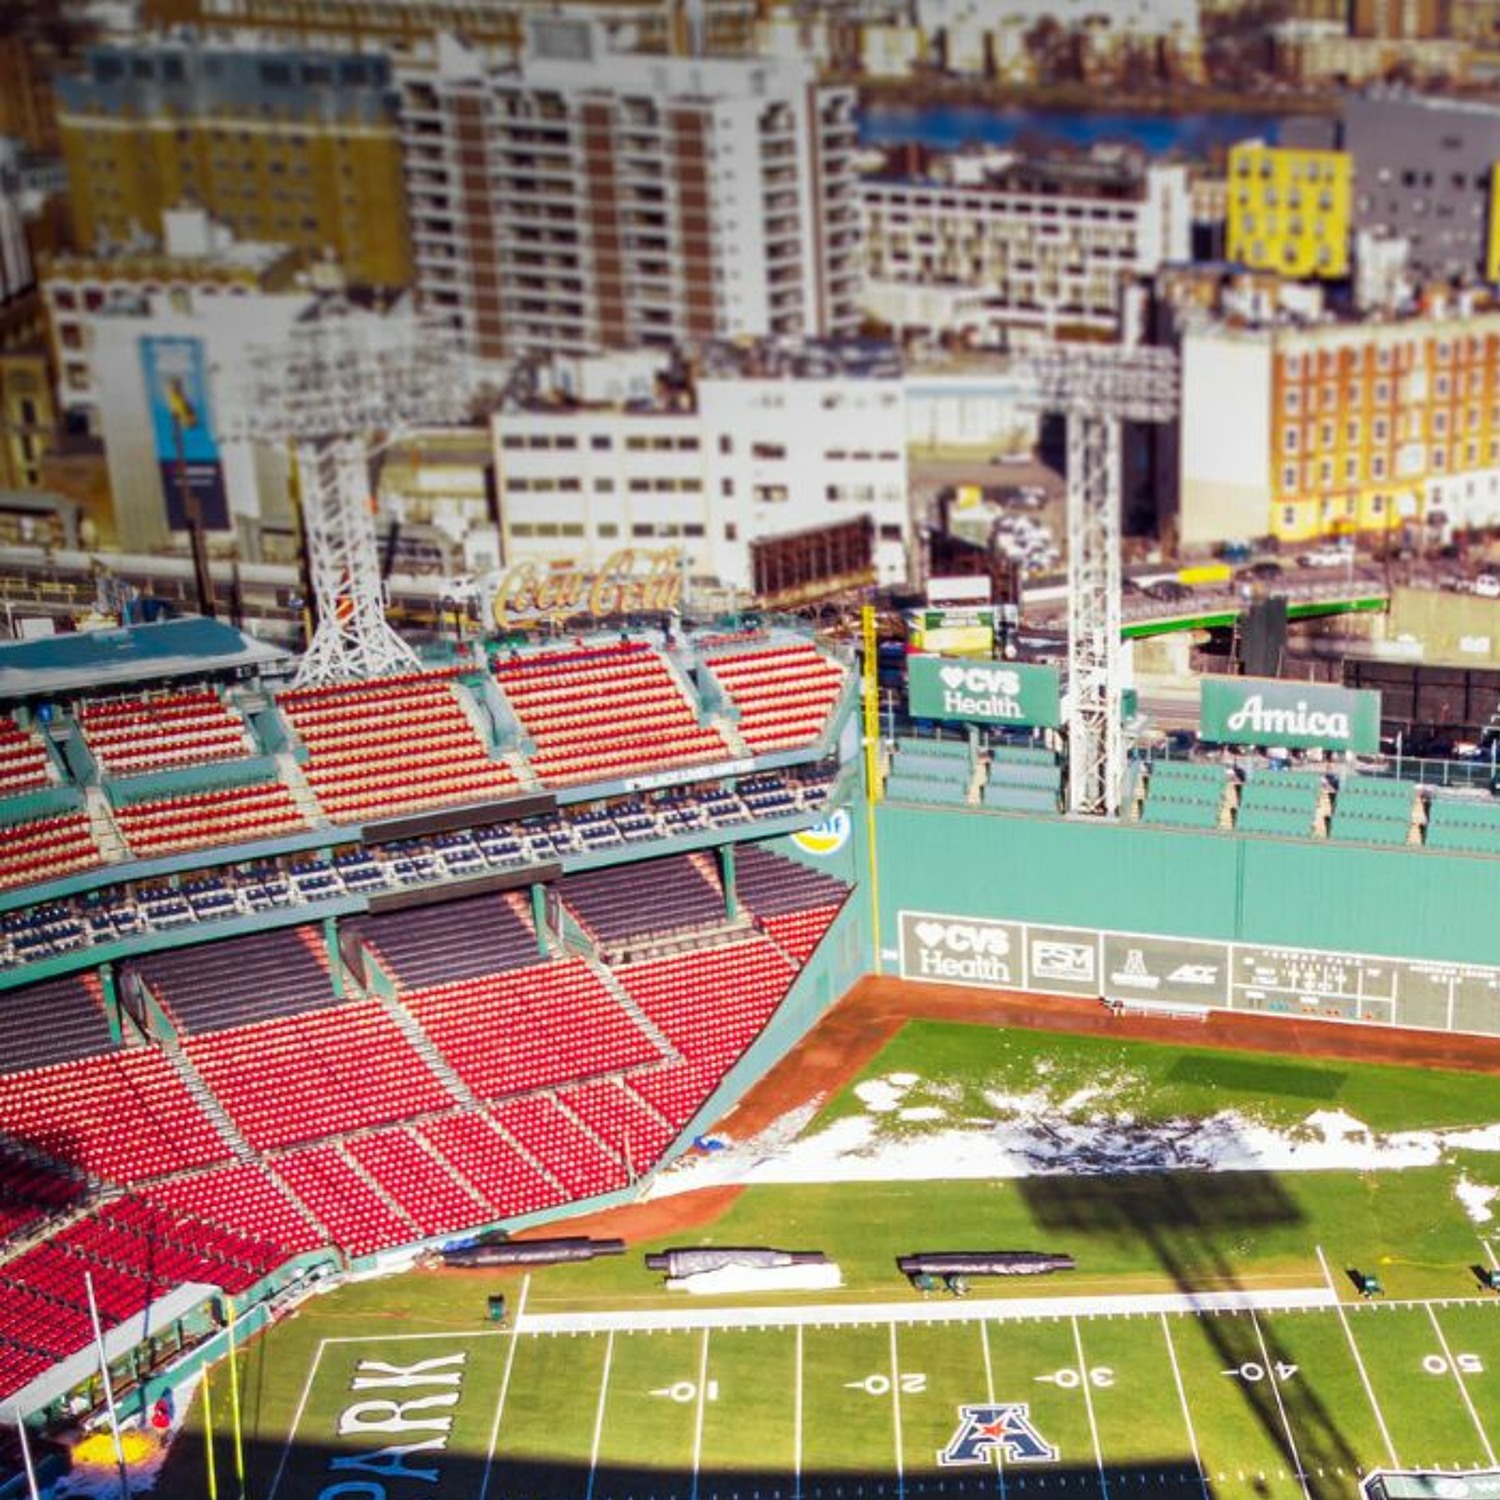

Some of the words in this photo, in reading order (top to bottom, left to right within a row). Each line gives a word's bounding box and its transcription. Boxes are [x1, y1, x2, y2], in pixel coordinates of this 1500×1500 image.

[966, 667, 1020, 695] CVS
[944, 690, 1022, 718] Health
[1228, 694, 1350, 738] Amica
[946, 924, 1010, 955] CVS
[919, 948, 1010, 982] Health
